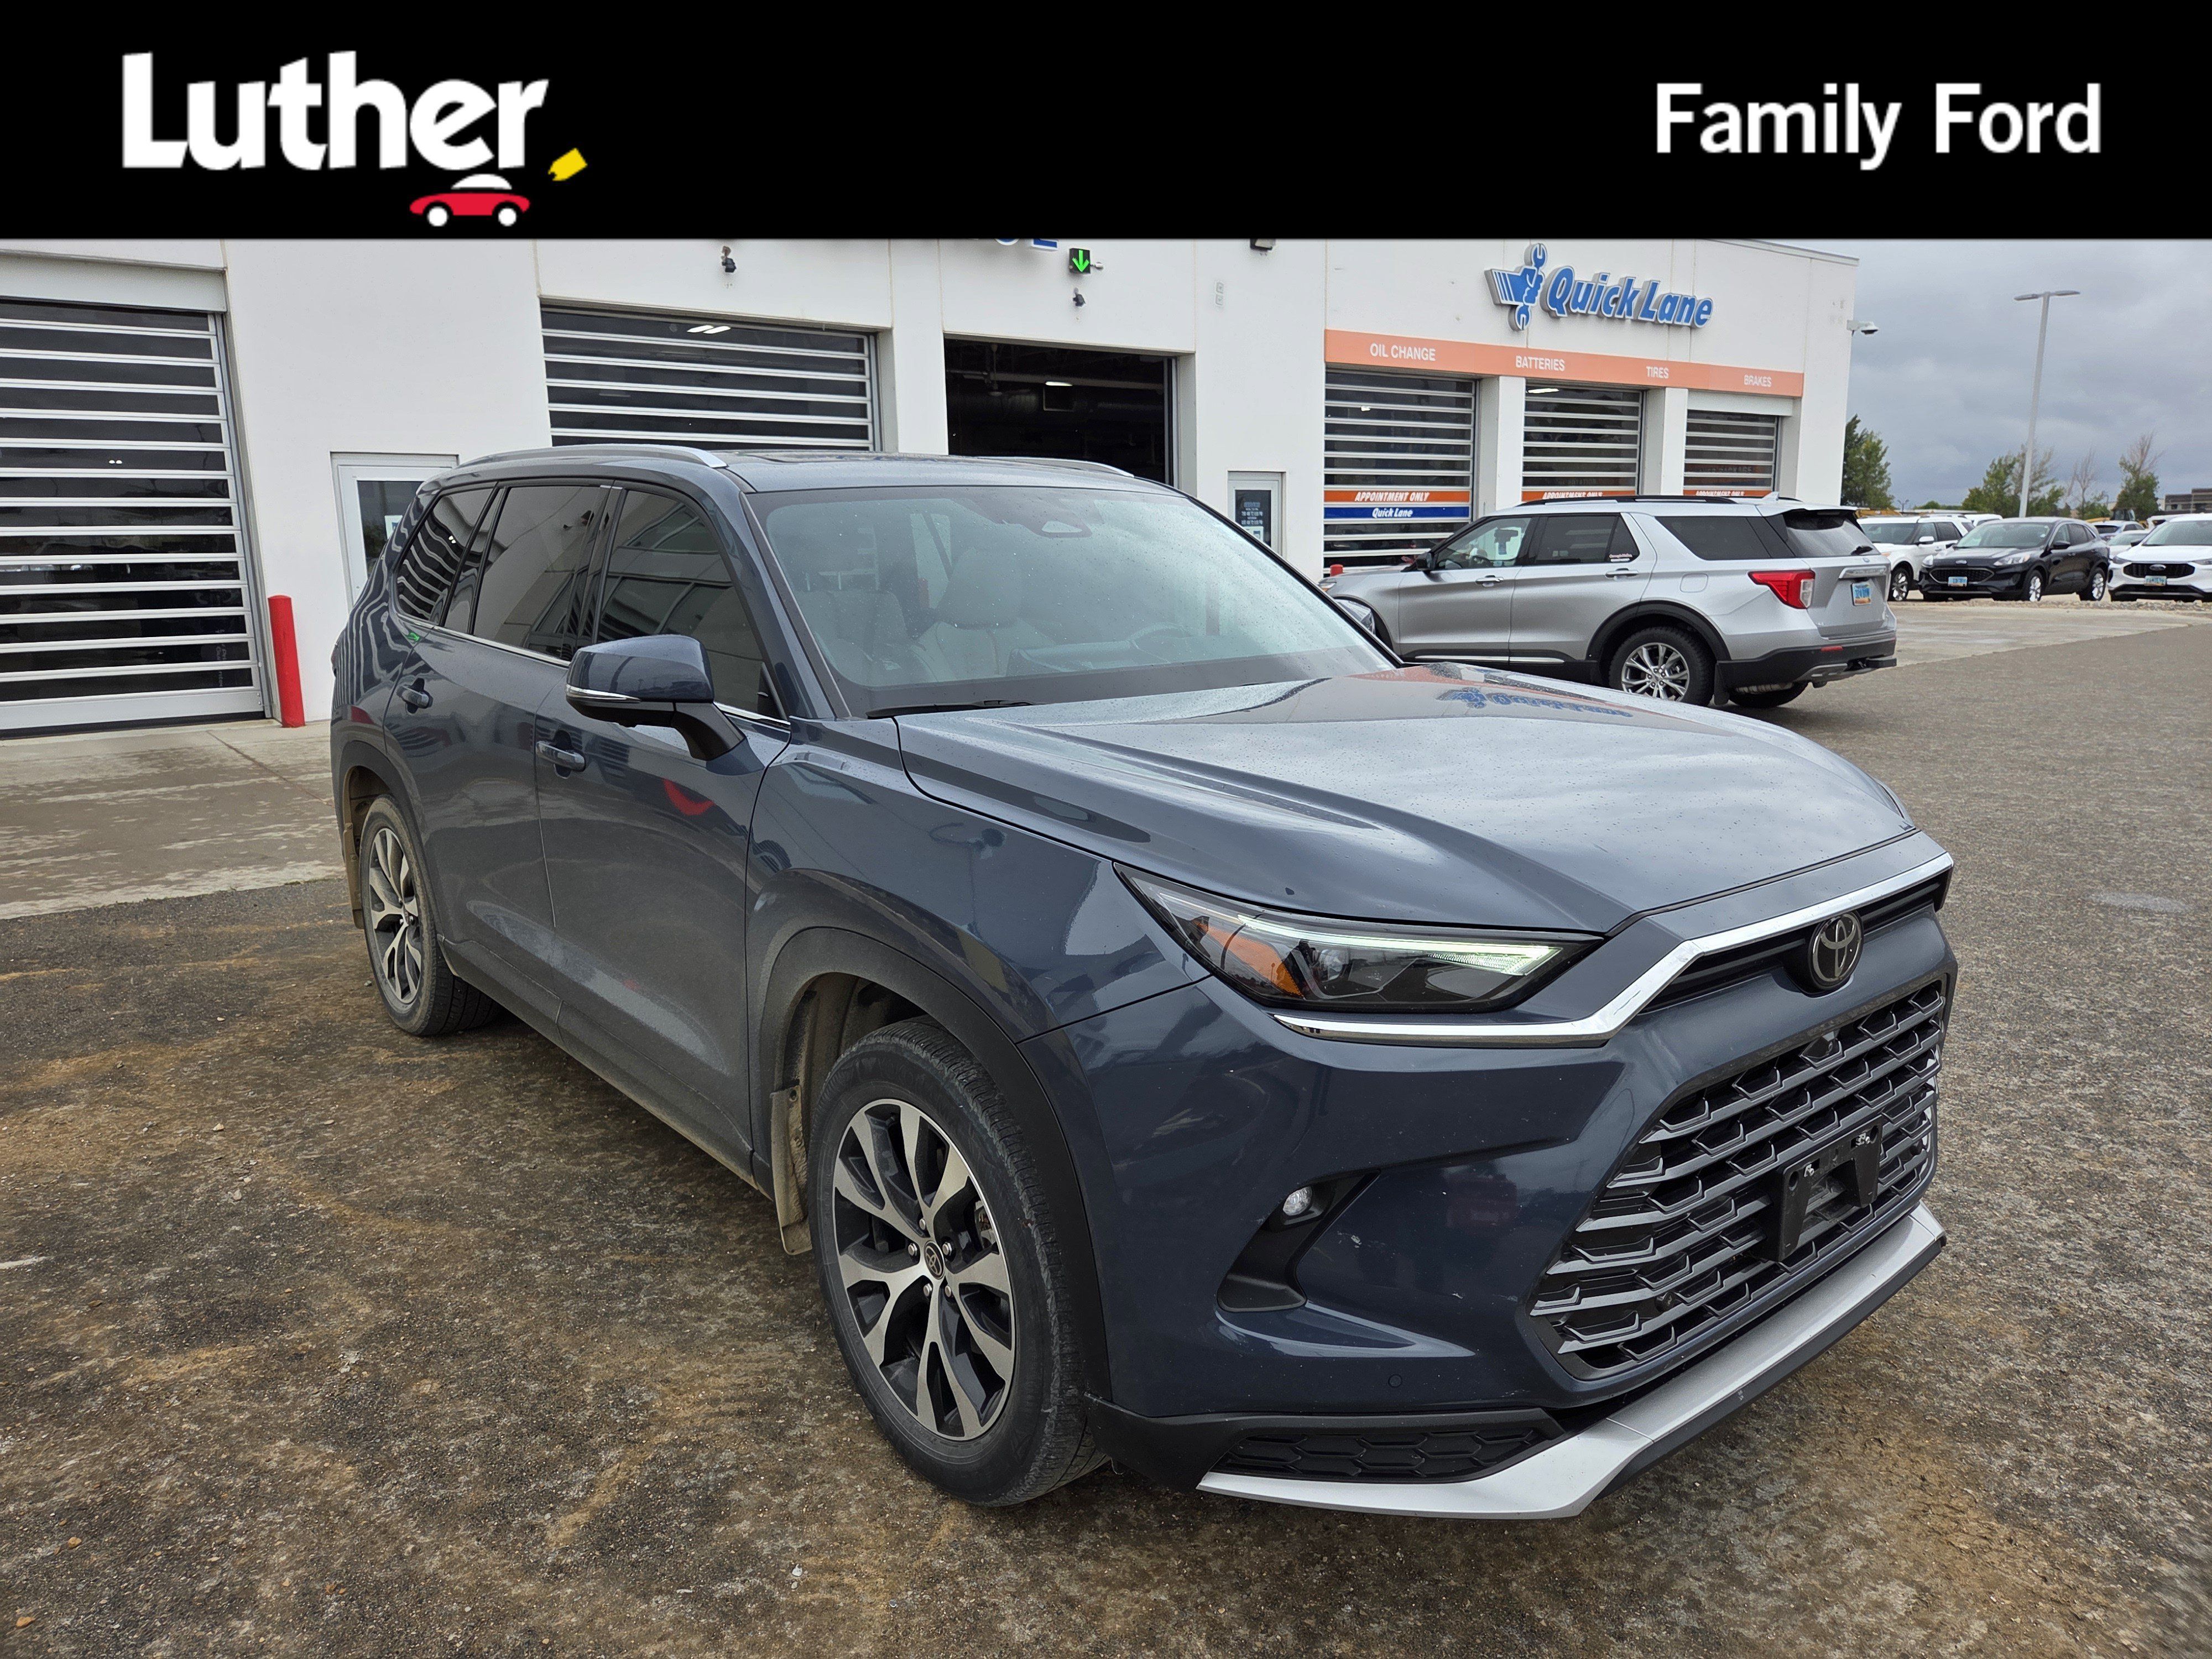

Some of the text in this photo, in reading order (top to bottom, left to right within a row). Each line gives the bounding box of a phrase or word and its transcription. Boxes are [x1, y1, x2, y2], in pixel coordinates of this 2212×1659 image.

[1543, 265, 1714, 328] Quick Lane
[1369, 343, 1436, 361] OIL CHANGE
[1515, 356, 1566, 372] BATTERIES
[1646, 366, 1669, 379] TIRES
[1744, 374, 1772, 387] BRAKES
[1354, 492, 1430, 502] APPOINTMENT ONLY
[1372, 508, 1413, 518] Quick Lane
